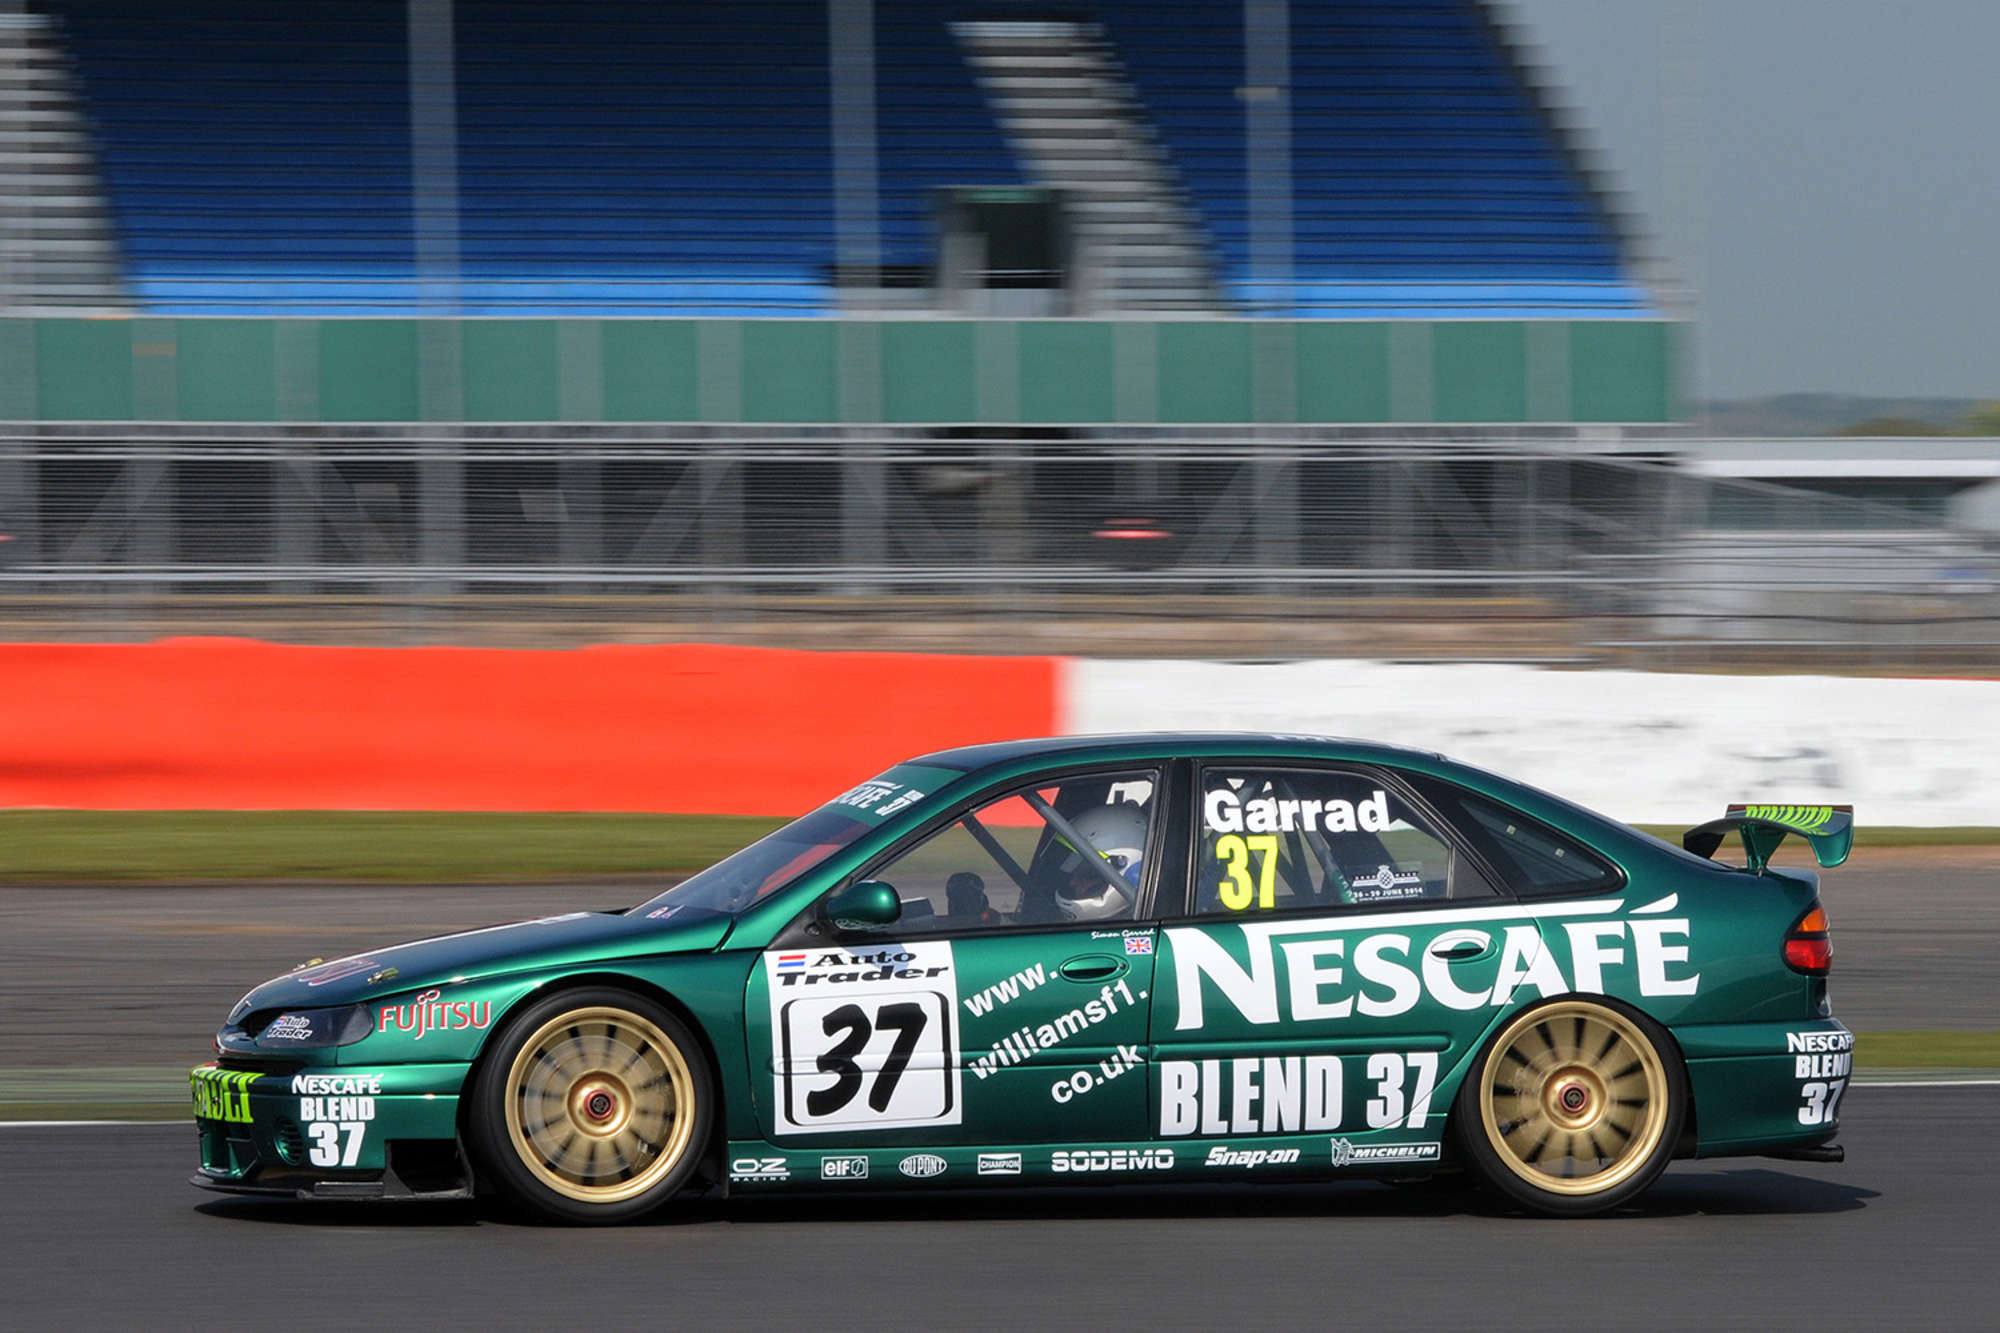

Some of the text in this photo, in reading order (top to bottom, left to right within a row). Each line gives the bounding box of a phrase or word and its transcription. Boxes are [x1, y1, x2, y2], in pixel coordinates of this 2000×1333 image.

[1204, 789, 1391, 833] Garrad
[1215, 834, 1278, 911] 37
[1382, 888, 1402, 896] JUNE
[1091, 931, 1120, 940] Simon
[776, 965, 949, 986] Trader
[811, 951, 917, 968] Auto
[1161, 893, 1700, 1031] NESCAFÉ
[963, 963, 1059, 1018] www.
[378, 989, 493, 1040] FUJITSU
[968, 979, 1148, 1081] williamsf1.
[806, 1003, 928, 1117] 37
[1051, 1043, 1143, 1104] co.uk
[291, 1073, 385, 1096] NESCAFÉ
[1160, 1051, 1439, 1137] BLEND 37
[300, 1097, 376, 1122] BLEND
[1798, 1079, 1845, 1125] 37
[308, 1121, 366, 1167] 37
[1051, 1149, 1175, 1172] SODEMO
[1204, 1147, 1301, 1169] Snap-on
[1354, 1146, 1436, 1158] MICHELIN
[824, 1160, 850, 1176] elf
[980, 1159, 1020, 1169] CHAMPION
